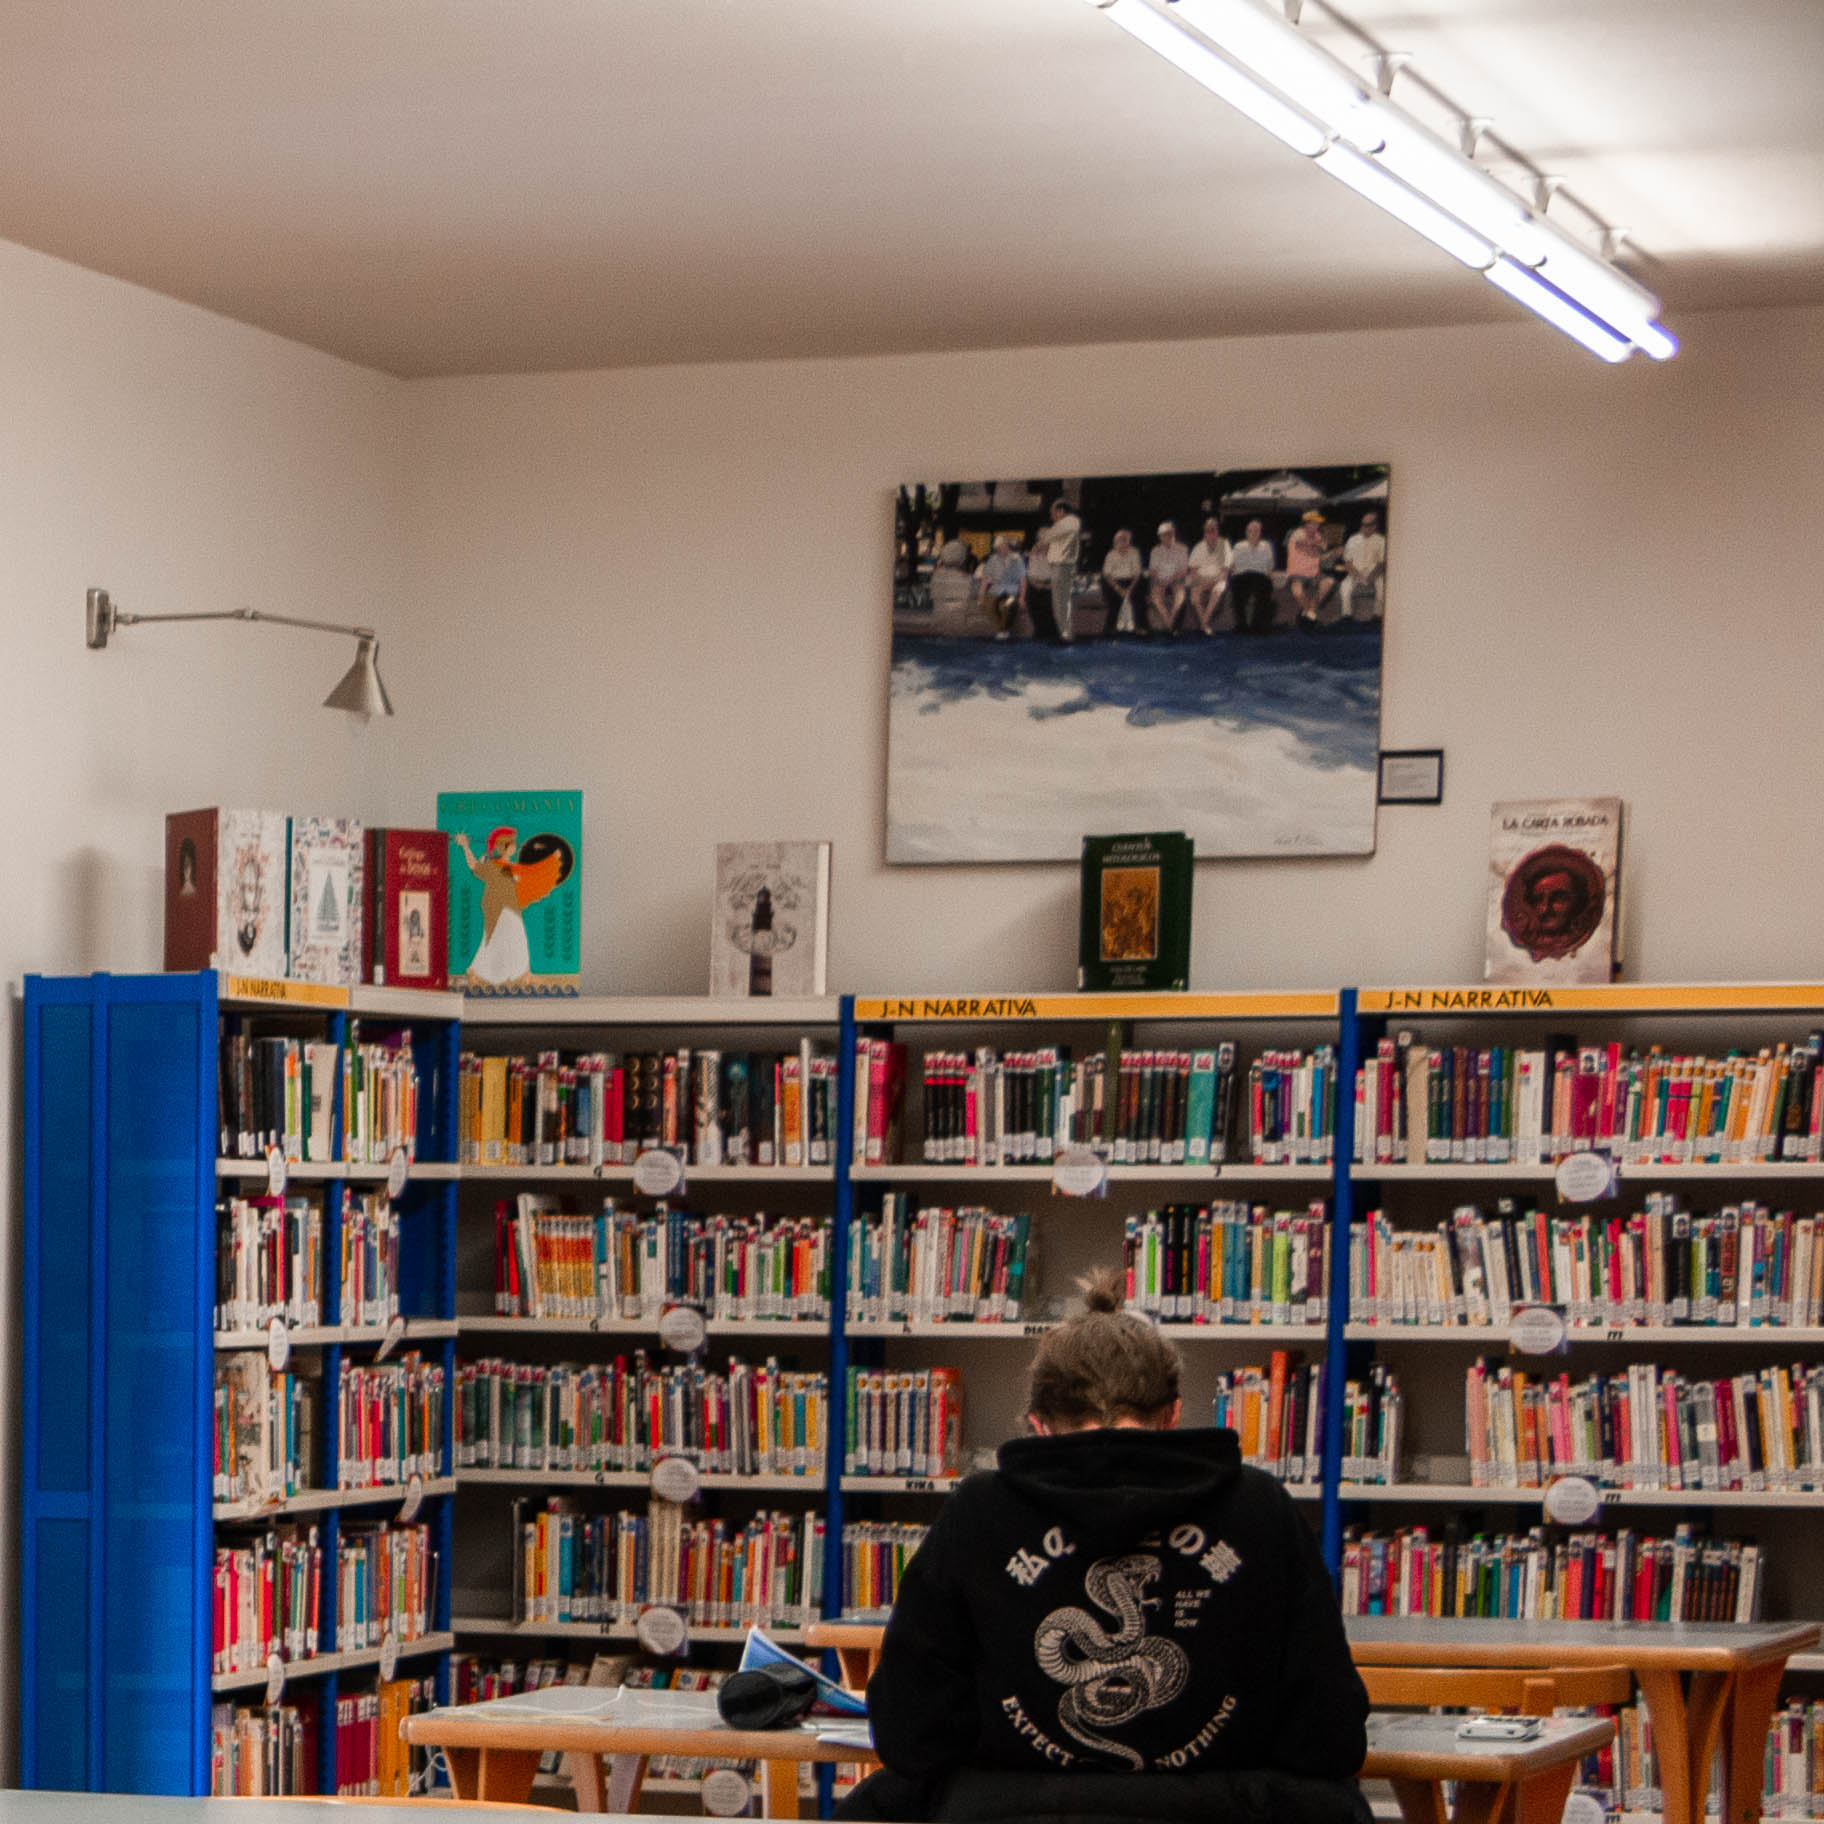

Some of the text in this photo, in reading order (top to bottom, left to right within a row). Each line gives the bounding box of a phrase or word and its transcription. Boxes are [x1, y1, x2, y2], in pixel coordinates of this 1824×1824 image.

[1503, 816, 1518, 830] LA
[1386, 990, 1553, 1008] J-N NARRATIVA
[880, 1000, 1037, 1018] J-N NARRATIVA
[1002, 1696, 1075, 1767] EXPECT
[1155, 1695, 1237, 1769] NOTHING
